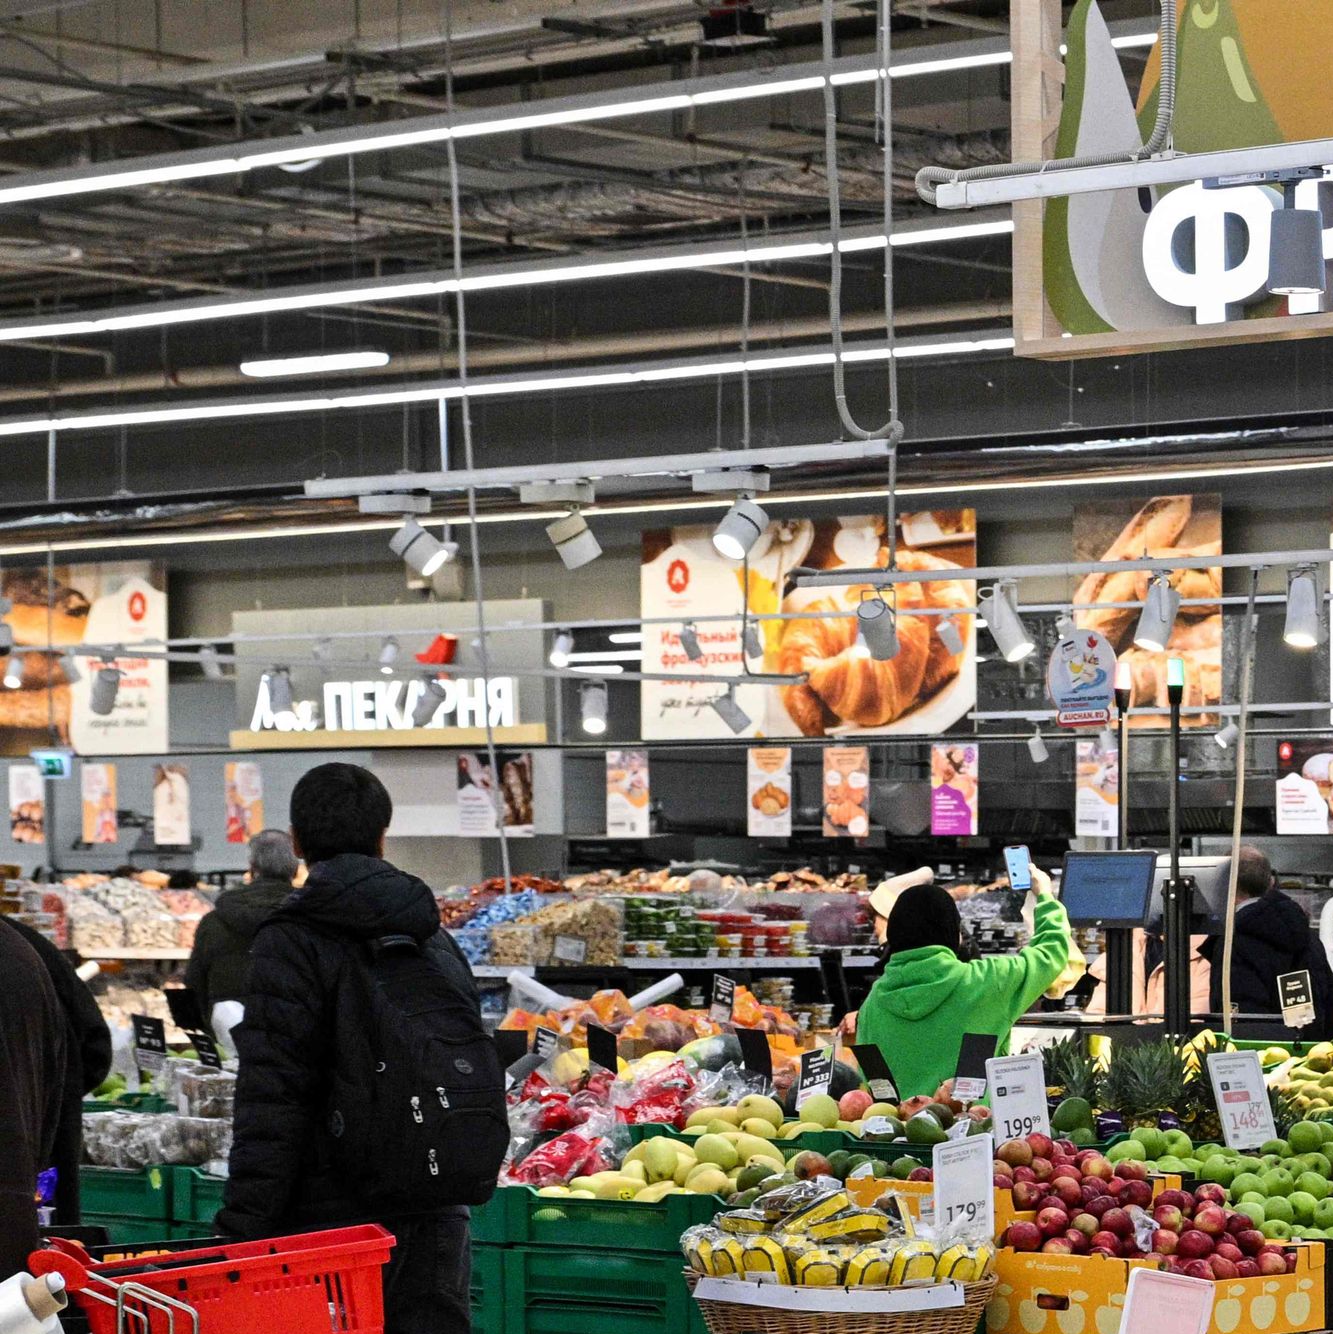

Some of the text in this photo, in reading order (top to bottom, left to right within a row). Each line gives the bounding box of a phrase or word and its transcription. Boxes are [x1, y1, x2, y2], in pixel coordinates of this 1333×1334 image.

[814, 1072, 831, 1085] 333
[1003, 1114, 1041, 1139] 199 99
